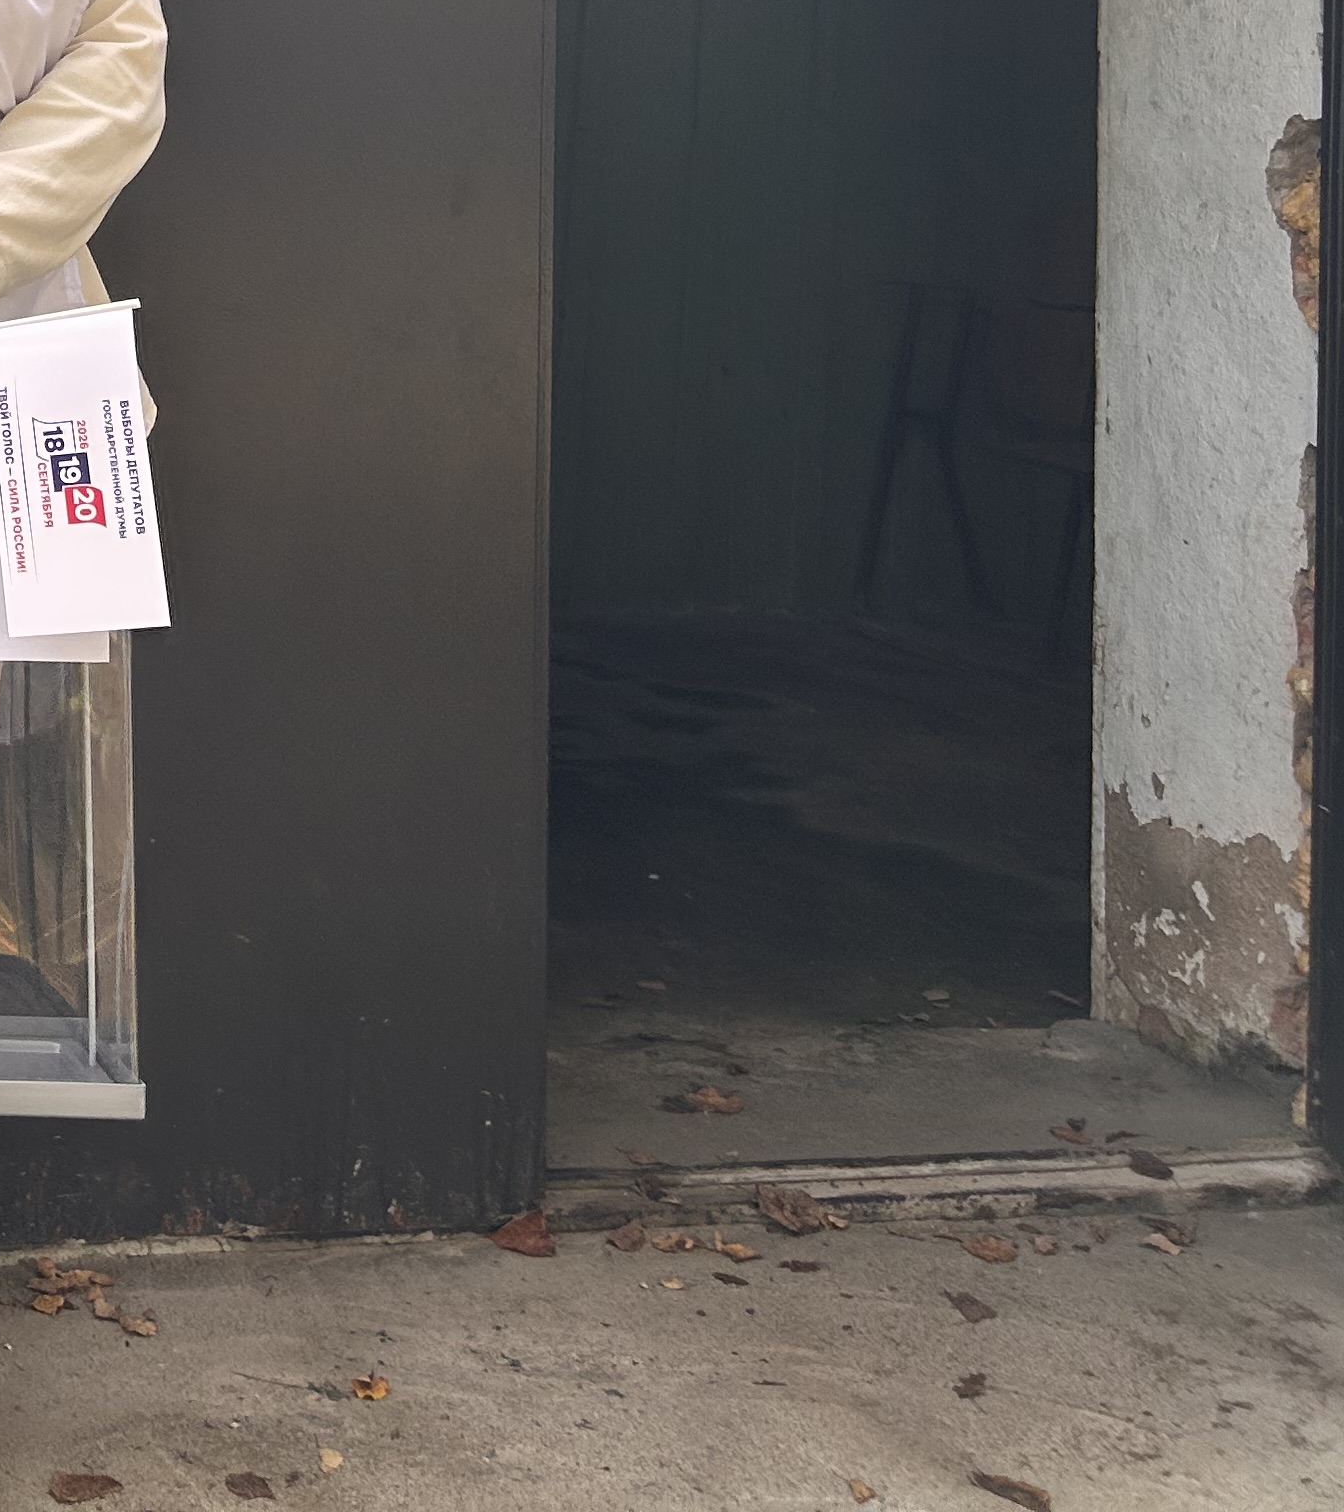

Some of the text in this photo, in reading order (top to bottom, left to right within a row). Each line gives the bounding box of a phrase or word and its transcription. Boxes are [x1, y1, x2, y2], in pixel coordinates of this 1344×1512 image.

[0, 422, 15, 463] ГОЛОС
[76, 420, 88, 449] 2026
[7, 478, 21, 513] СИЛА
[37, 462, 54, 528] СЕНТЯБРЯ
[42, 426, 97, 521] 18 19 20
[101, 399, 127, 539] ГОСУДАРСТВЕННОЙ ДУМЫ
[120, 400, 146, 535] ВЫБОРЫ ДЕПУТАТОВ
[12, 515, 27, 574] РОССИИ!
